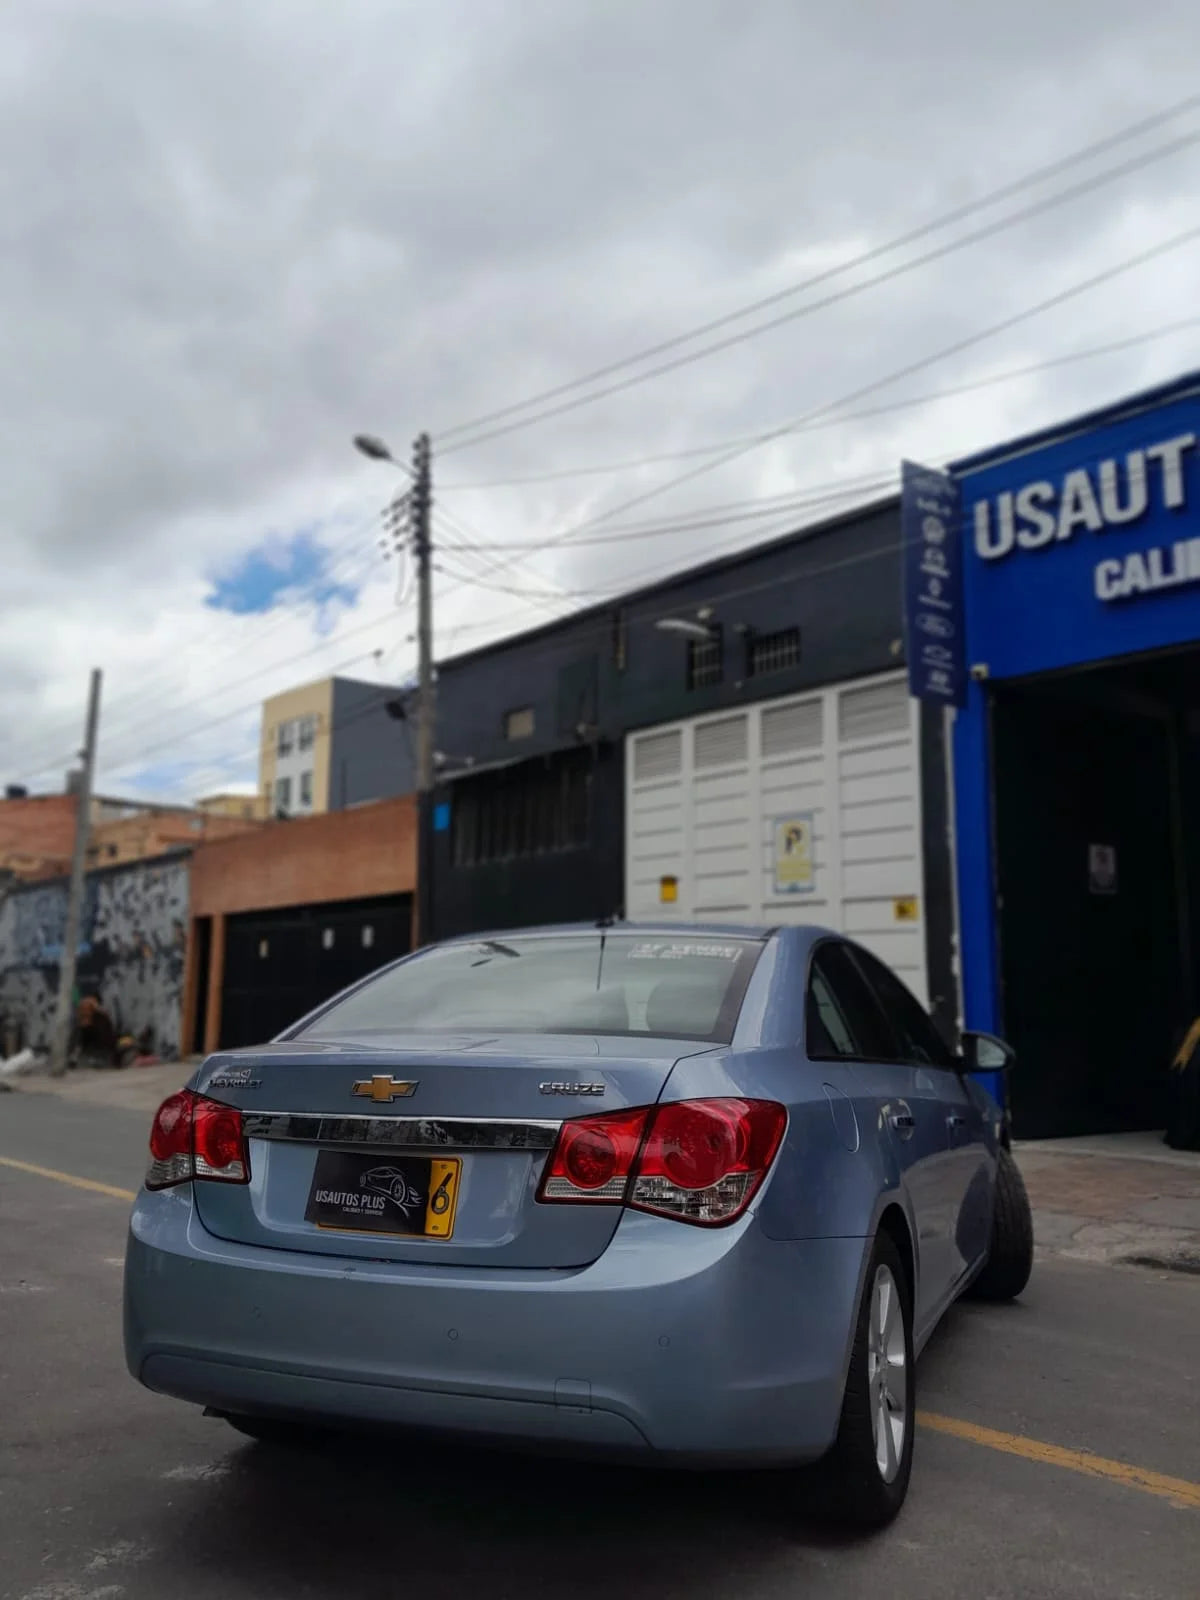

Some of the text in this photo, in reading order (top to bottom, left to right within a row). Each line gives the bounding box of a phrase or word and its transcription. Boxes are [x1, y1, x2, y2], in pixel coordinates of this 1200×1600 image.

[539, 1082, 605, 1096] CRUZE
[315, 1190, 386, 1210] USAUTOS PLUS
[431, 1172, 453, 1215] 6
